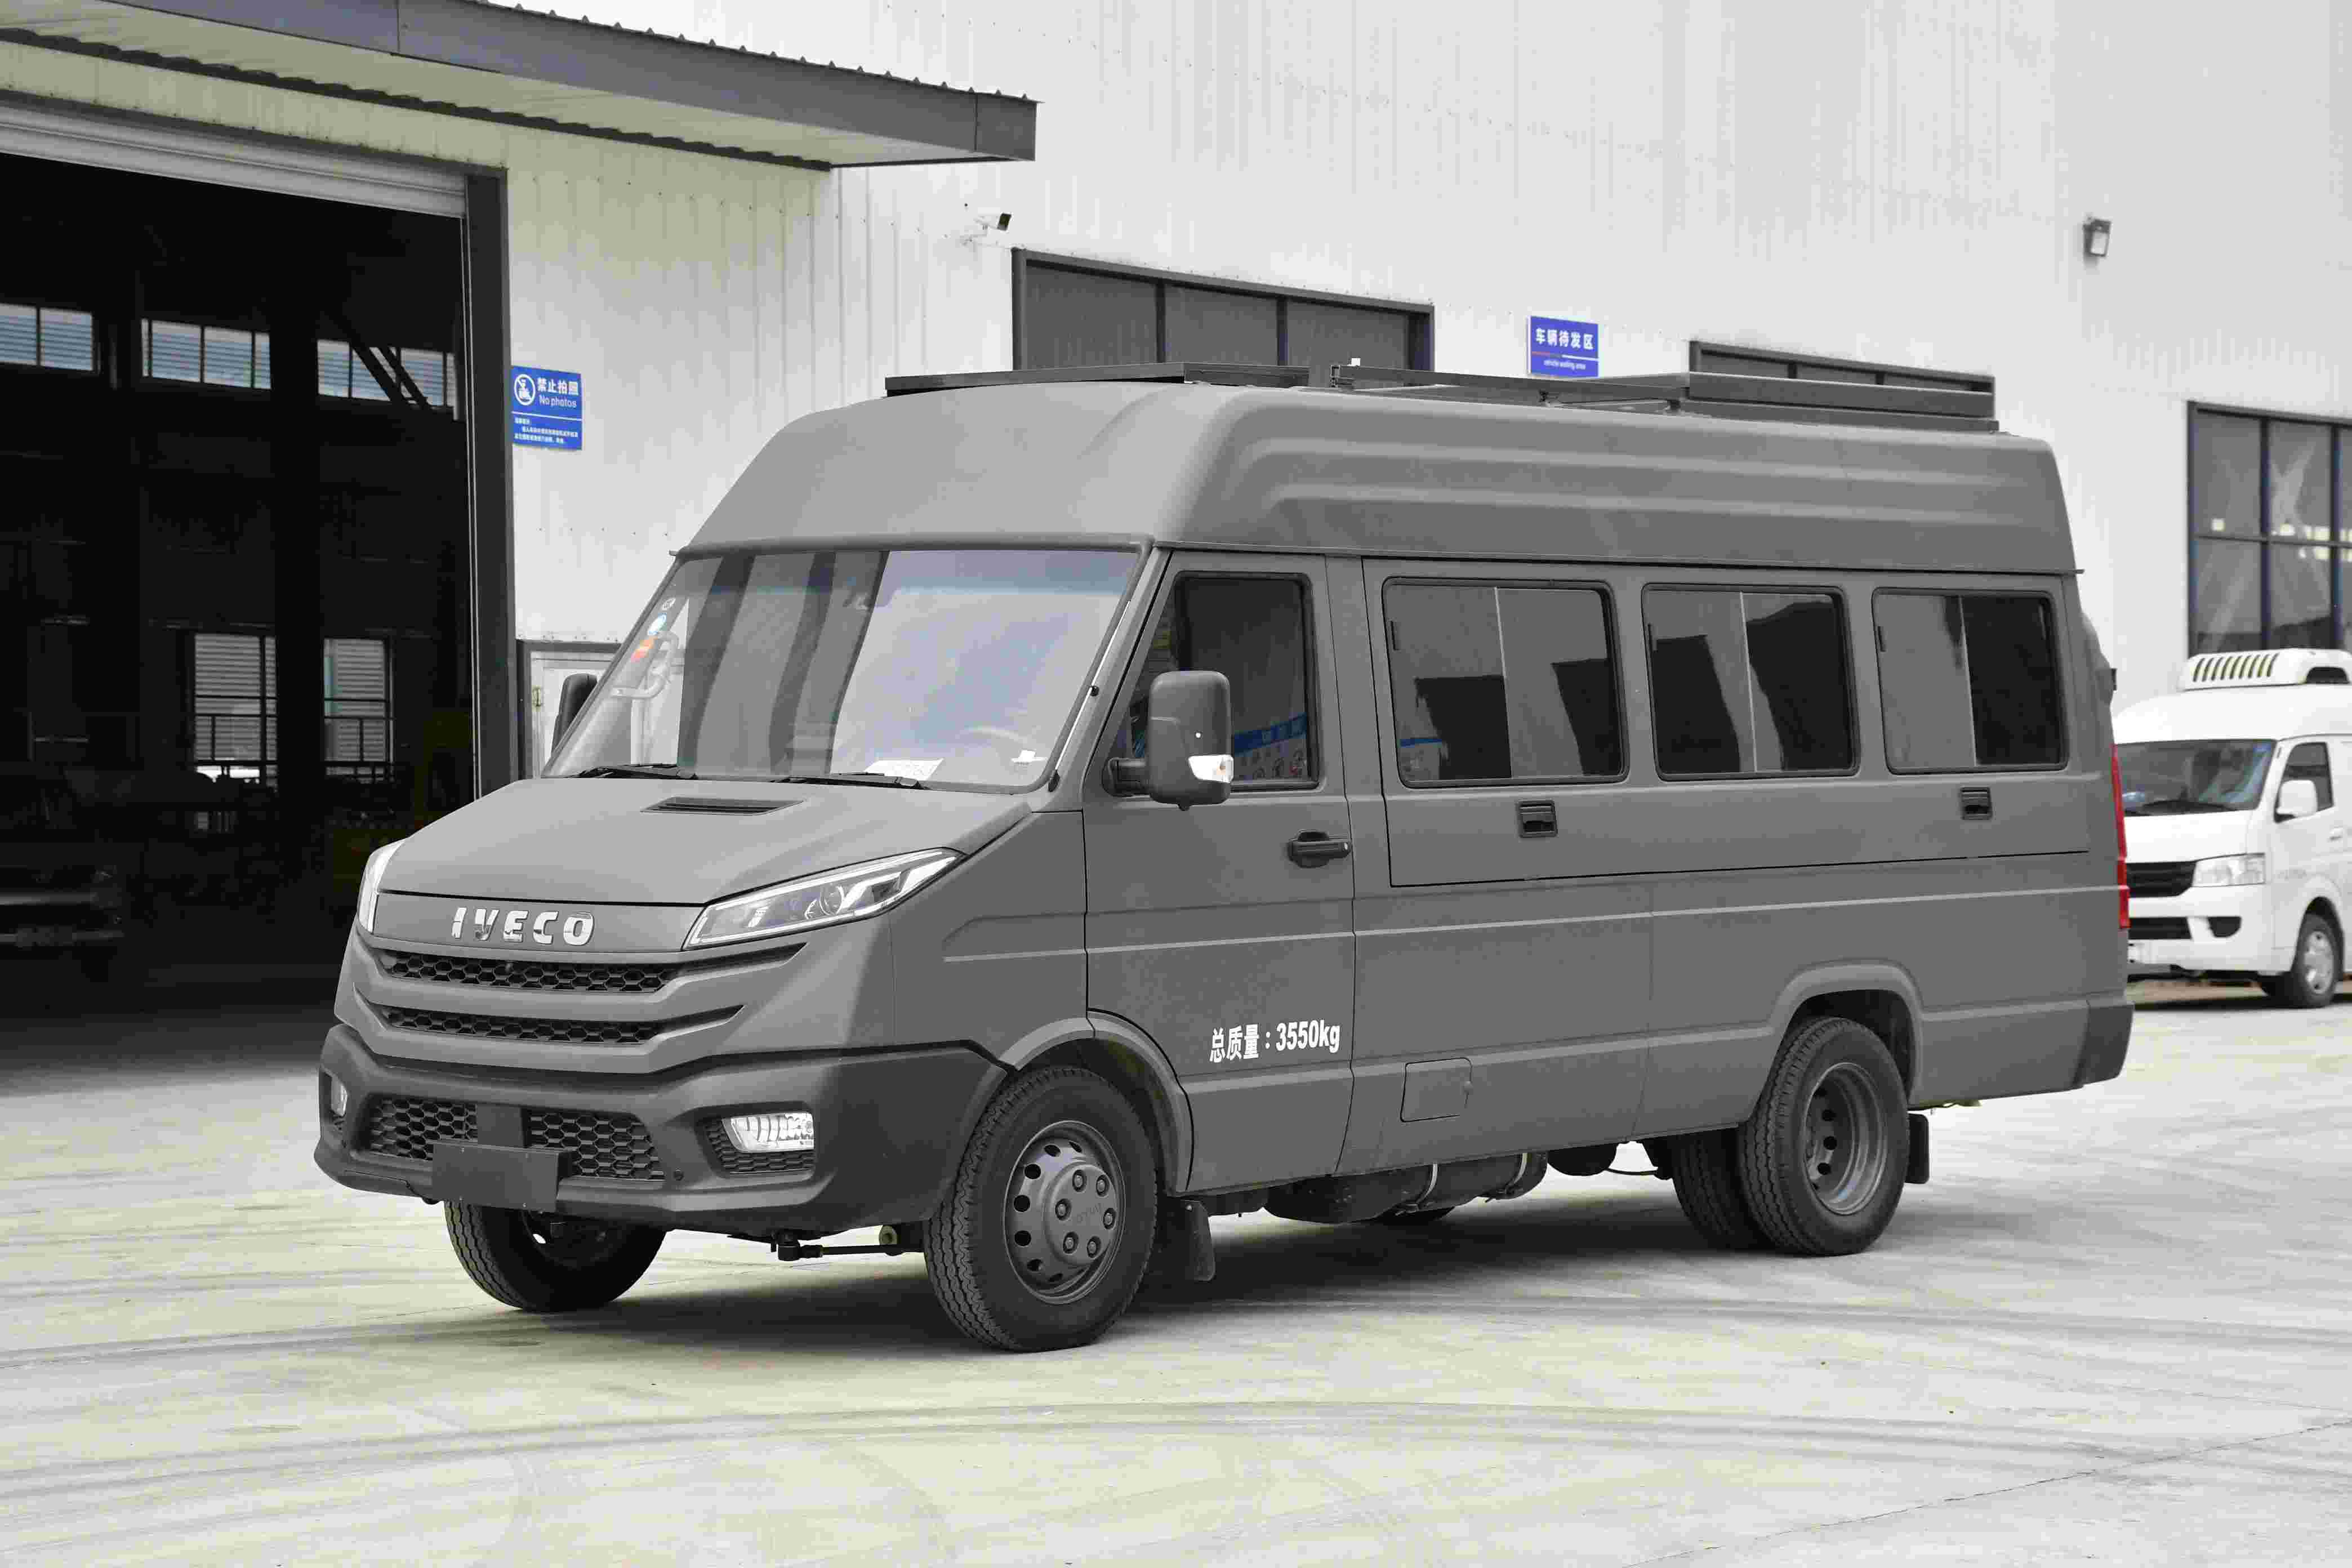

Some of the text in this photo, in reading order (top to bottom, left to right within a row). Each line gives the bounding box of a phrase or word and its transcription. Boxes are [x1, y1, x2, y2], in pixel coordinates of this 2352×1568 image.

[1535, 328, 1594, 350] 车辆待发区
[539, 394, 577, 408] No photos
[451, 907, 595, 946] IVECO
